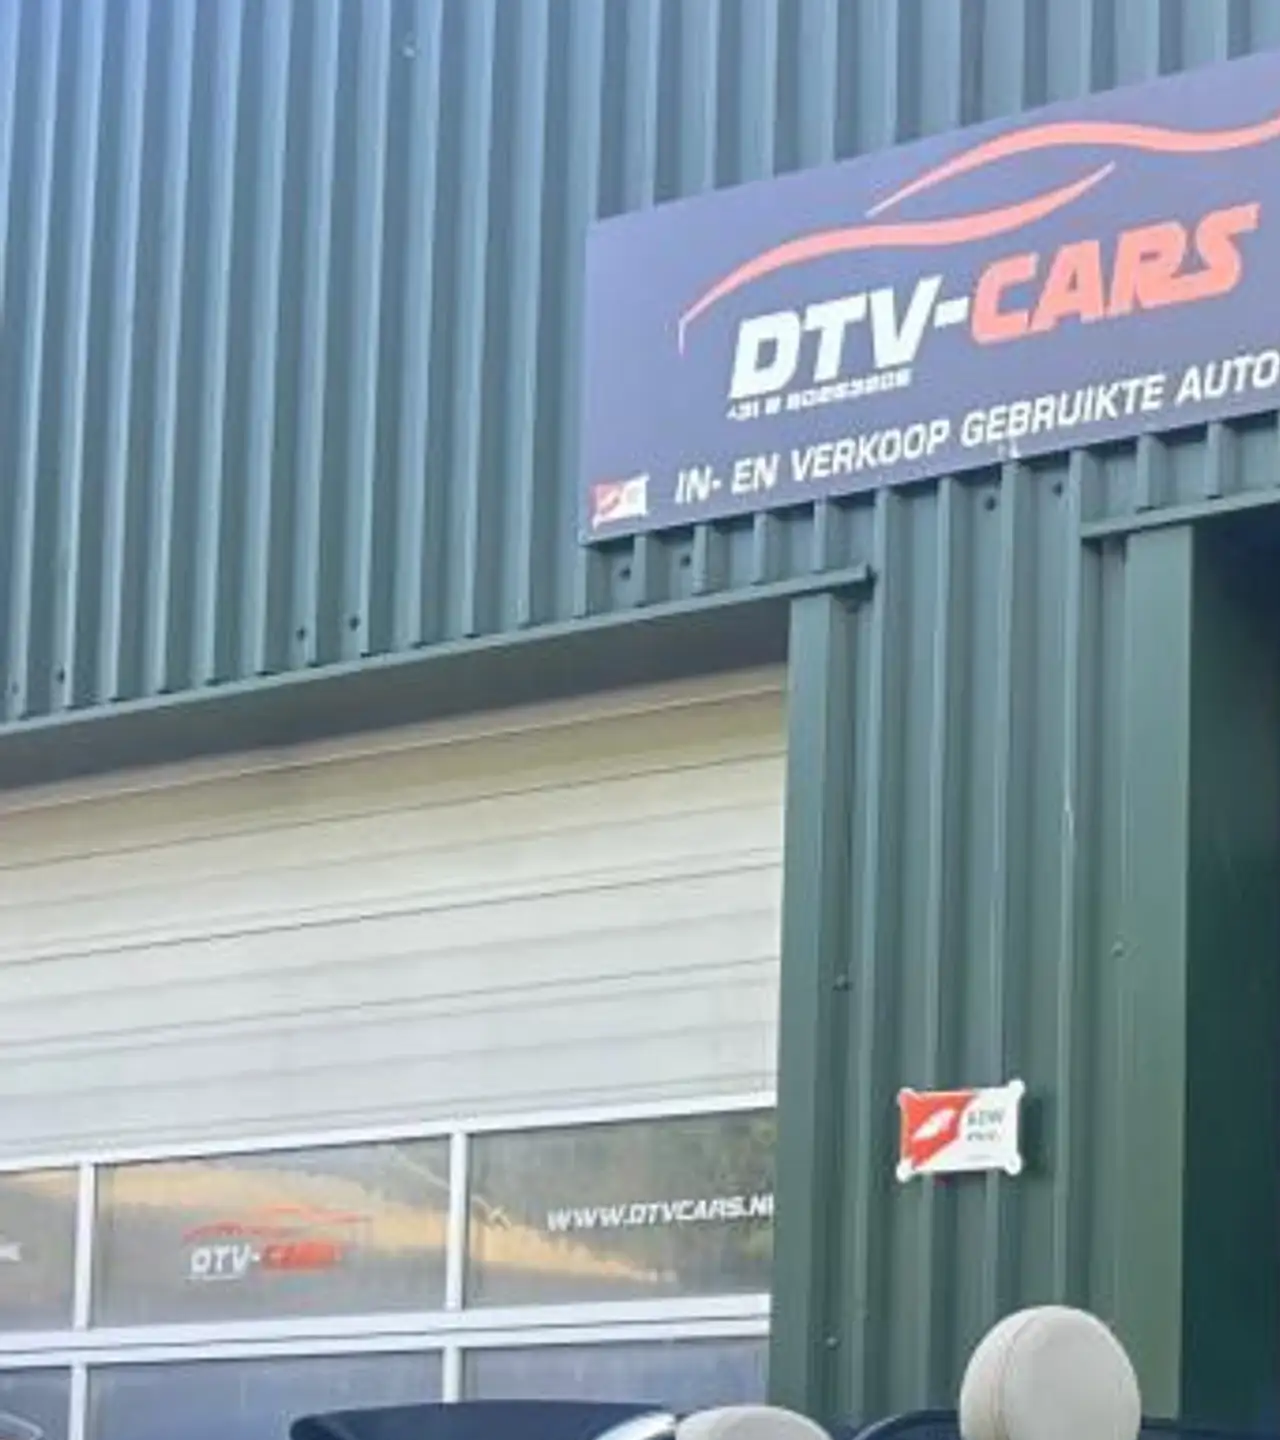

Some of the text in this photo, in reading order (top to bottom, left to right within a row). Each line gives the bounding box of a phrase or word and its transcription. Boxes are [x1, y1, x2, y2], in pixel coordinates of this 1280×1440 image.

[727, 203, 1261, 399] DTV-CARS
[674, 464, 722, 504] IN-
[731, 453, 780, 495] EN
[790, 419, 951, 482] VERKOOP
[960, 373, 1167, 447] GEBRUIKTE
